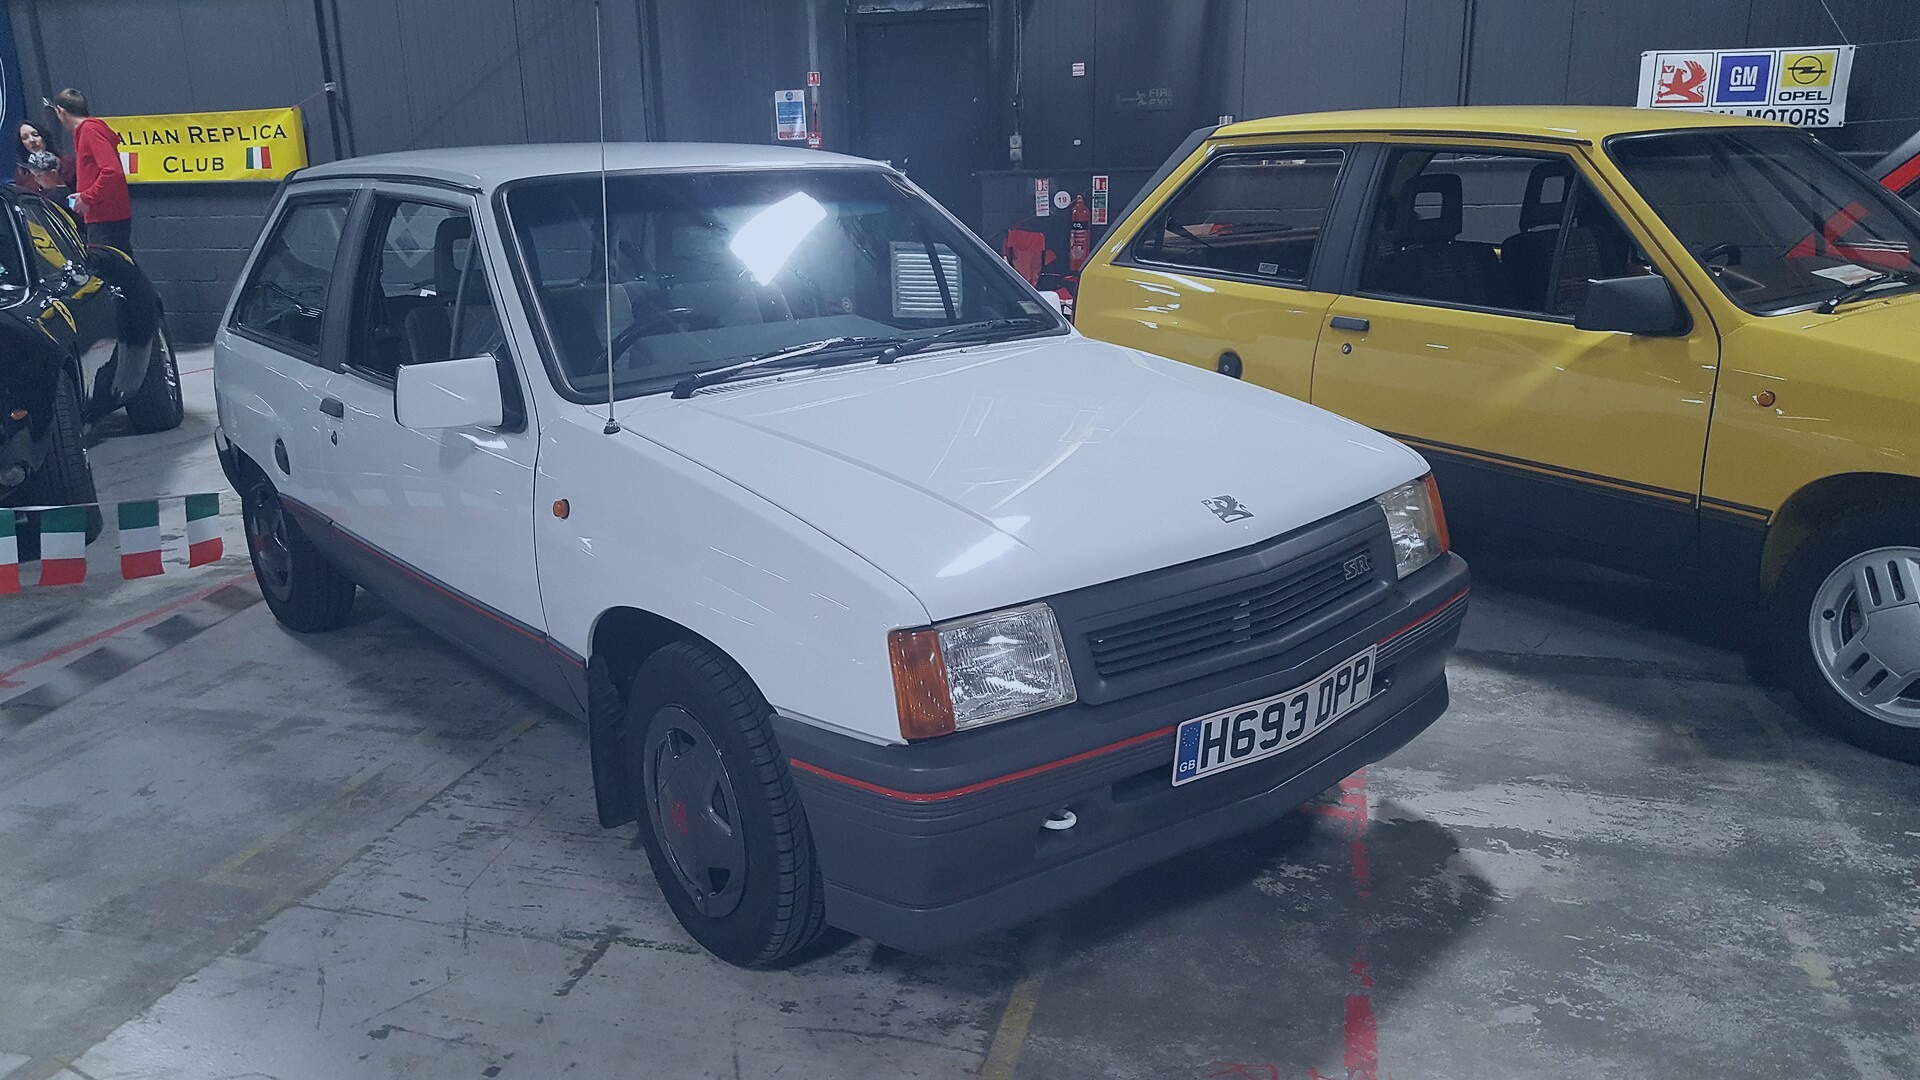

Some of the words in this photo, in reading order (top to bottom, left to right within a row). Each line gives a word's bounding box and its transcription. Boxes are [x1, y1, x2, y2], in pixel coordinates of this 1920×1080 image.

[1730, 65, 1759, 86] GM
[1778, 90, 1828, 101] OPEL
[117, 129, 179, 146] ALIAN
[187, 124, 288, 144] REPLICA
[163, 156, 225, 173] CLUB
[1343, 554, 1371, 581] SR
[1200, 691, 1308, 770] H693
[1314, 655, 1370, 727] DPP
[1179, 759, 1196, 773] GB
